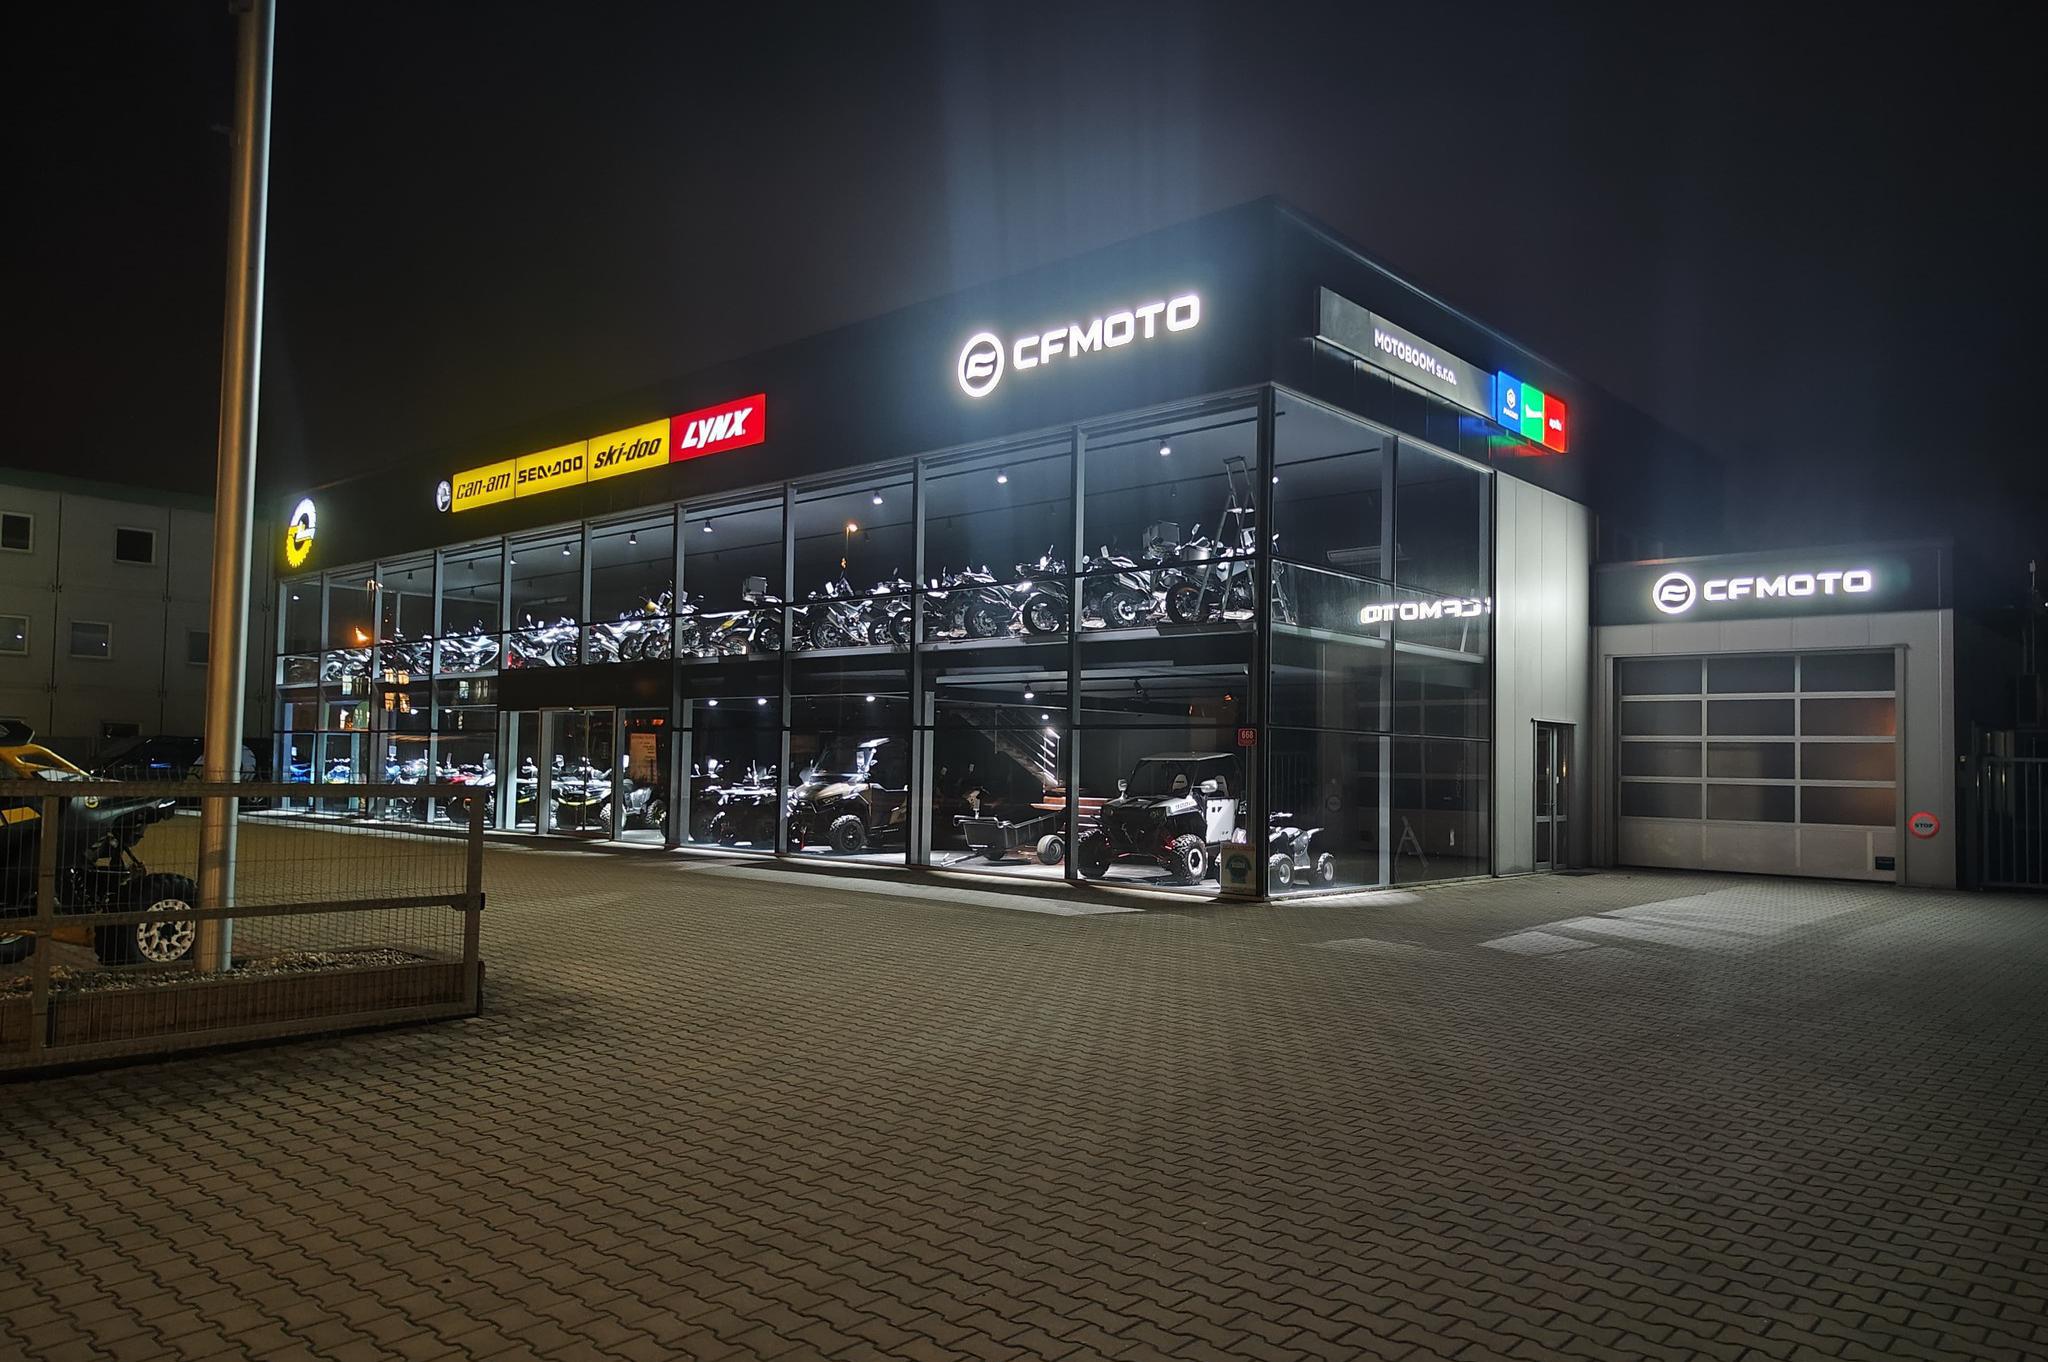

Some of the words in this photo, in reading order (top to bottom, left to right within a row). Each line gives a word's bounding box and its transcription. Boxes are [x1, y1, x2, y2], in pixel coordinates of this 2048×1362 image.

[1013, 294, 1201, 370] CFMOTO
[1374, 328, 1435, 375] MOTOBOOM
[1436, 364, 1457, 385] s.r.o.
[680, 407, 753, 449] LYNX
[594, 437, 662, 469] ski-doo
[456, 471, 511, 499] can-am
[1703, 569, 1873, 602] CFMOTO
[1241, 730, 1254, 739] 668
